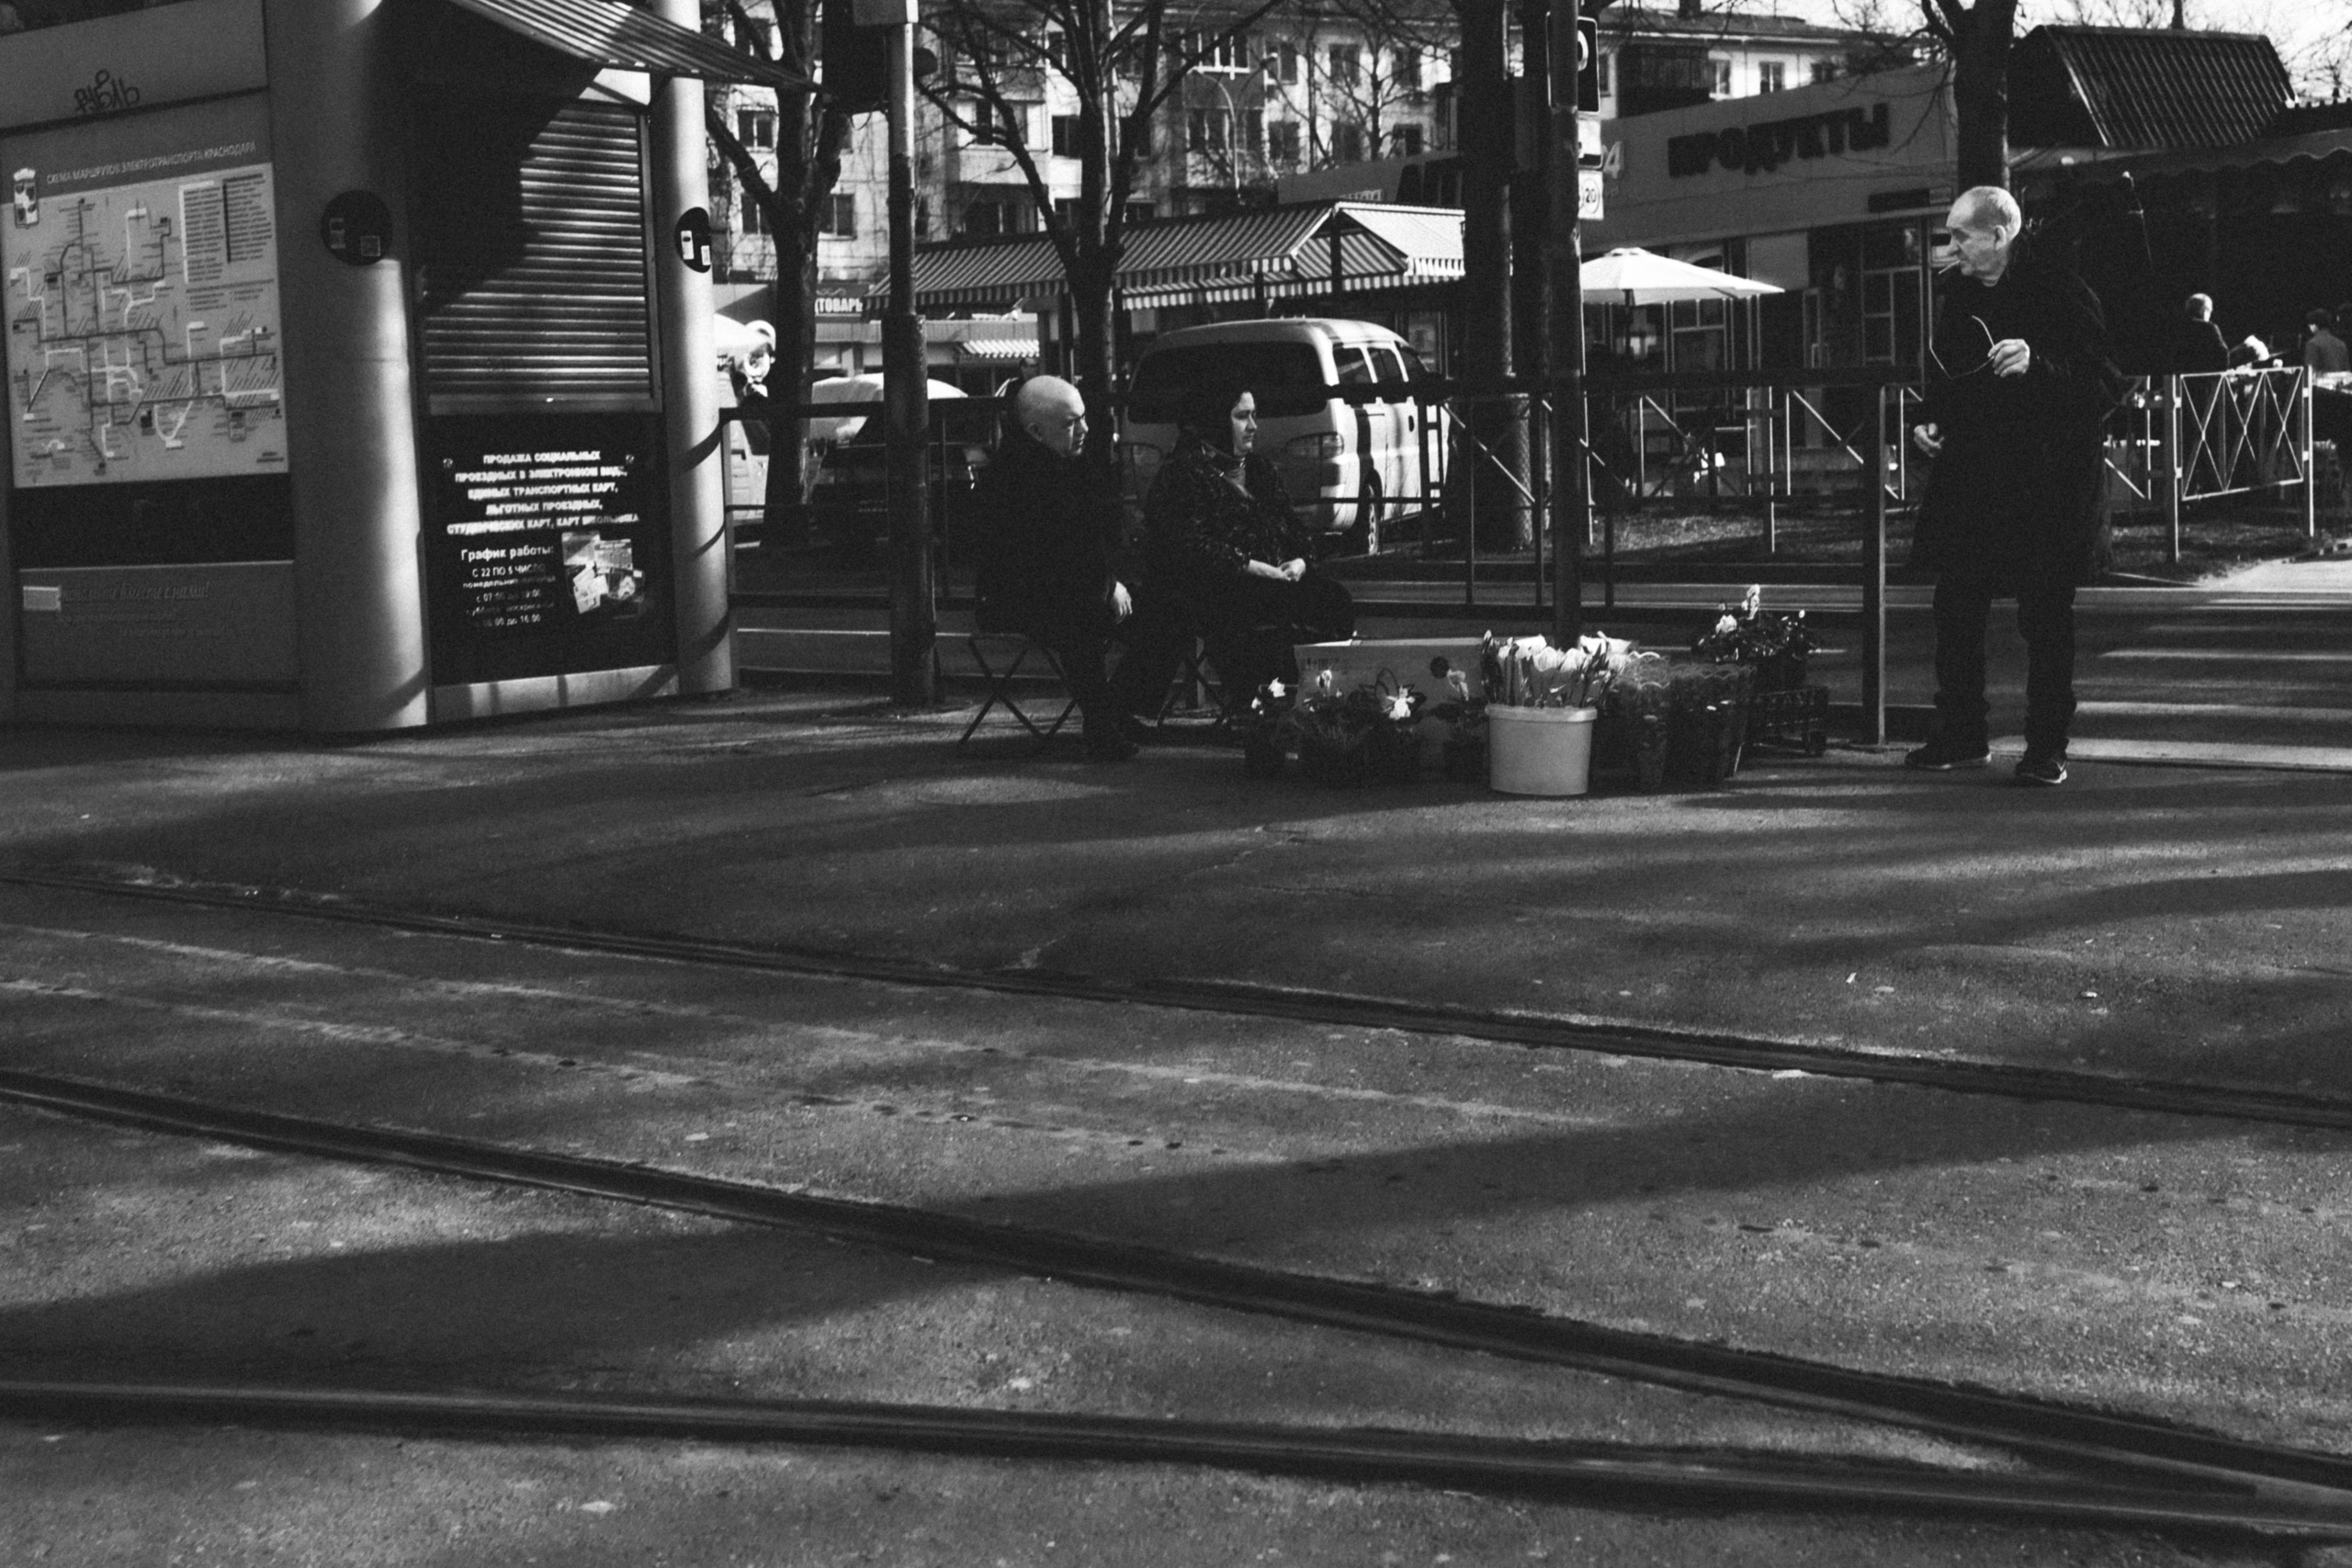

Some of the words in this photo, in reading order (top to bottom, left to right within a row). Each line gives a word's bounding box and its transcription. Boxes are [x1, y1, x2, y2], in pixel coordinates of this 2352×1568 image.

[1668, 101, 1891, 177] ПРОДУКТЫ
[47, 171, 71, 185] СХЕМА
[73, 164, 120, 180] МАРШРУТОВ
[121, 150, 203, 174] ЭЛЕКТРОТРАНСПОРТА
[204, 141, 256, 160] КРАСНОДАРА
[1585, 187, 1597, 204] 20
[482, 453, 532, 465] ПРОДАЖА
[534, 450, 601, 464] СОЦИАЛЬНЫХ
[455, 470, 516, 483] ПРОЕЗДНЫХ
[519, 470, 526, 479] В
[528, 467, 598, 479] ЭЛЕКТРОННОМ
[468, 487, 511, 501] ЕДИНЫХ
[513, 483, 591, 497] ТРАНСПОРТНЫХ
[592, 482, 618, 493] КАРТ,
[485, 502, 540, 516] ЛЬГОТНЫХ
[542, 499, 604, 512] ПРОЕЗДНЫХ,
[556, 516, 581, 527] КАРТ
[582, 513, 639, 526] ШКОЛЬНИКА
[461, 547, 506, 563] График
[471, 568, 479, 578] С
[481, 567, 491, 578] 22
[492, 566, 506, 576] ПО
